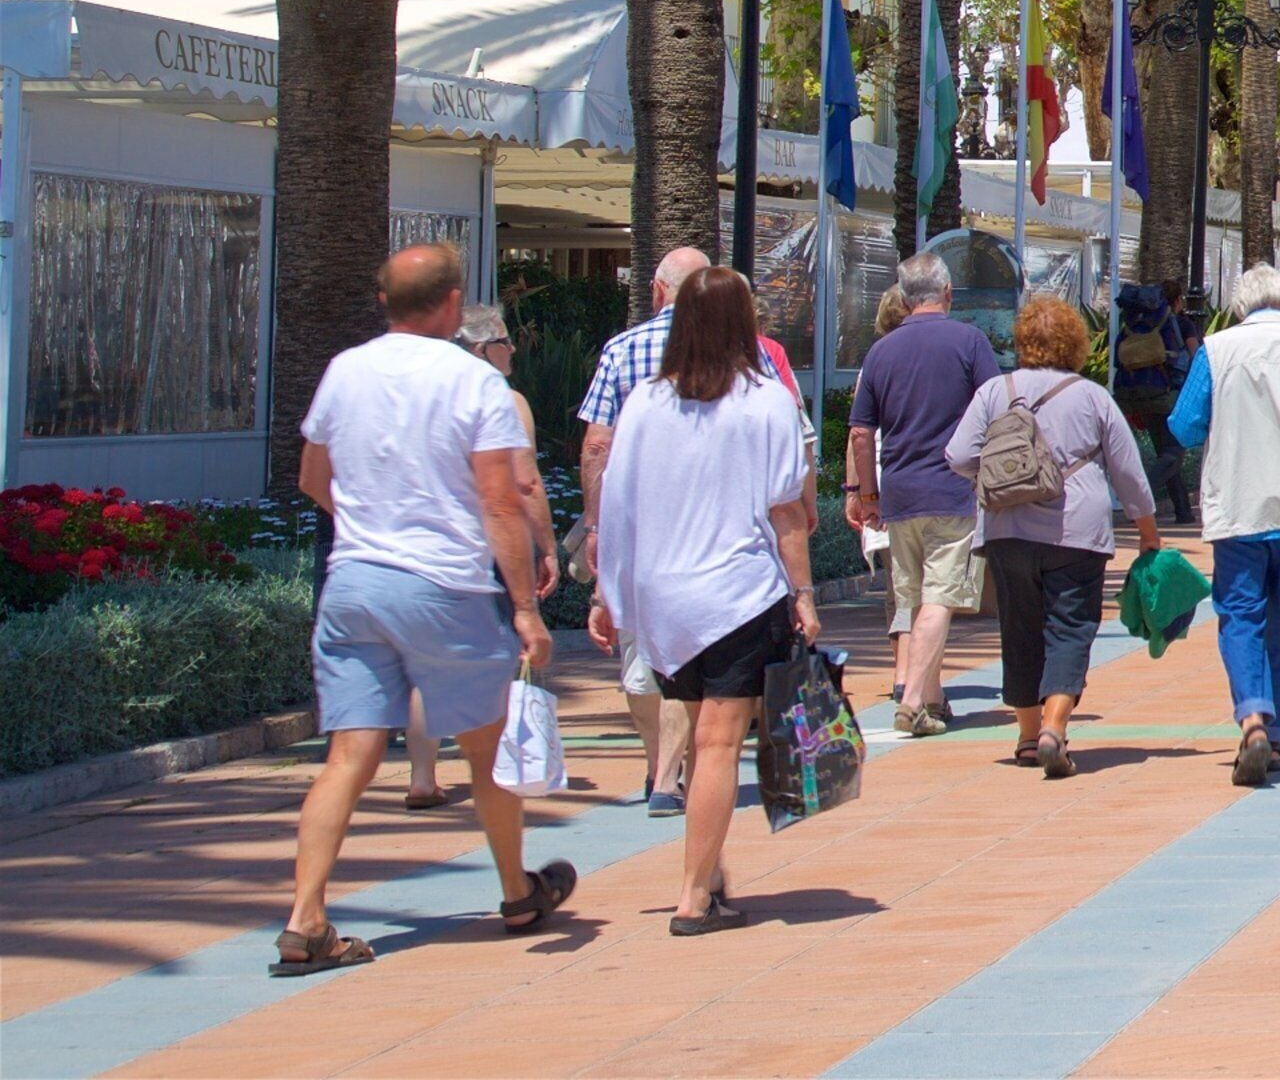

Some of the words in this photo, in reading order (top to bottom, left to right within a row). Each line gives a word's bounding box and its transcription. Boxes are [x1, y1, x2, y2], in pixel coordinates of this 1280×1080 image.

[155, 29, 278, 88] CAFETERI
[432, 82, 495, 122] SNACK
[774, 138, 797, 168] BAR
